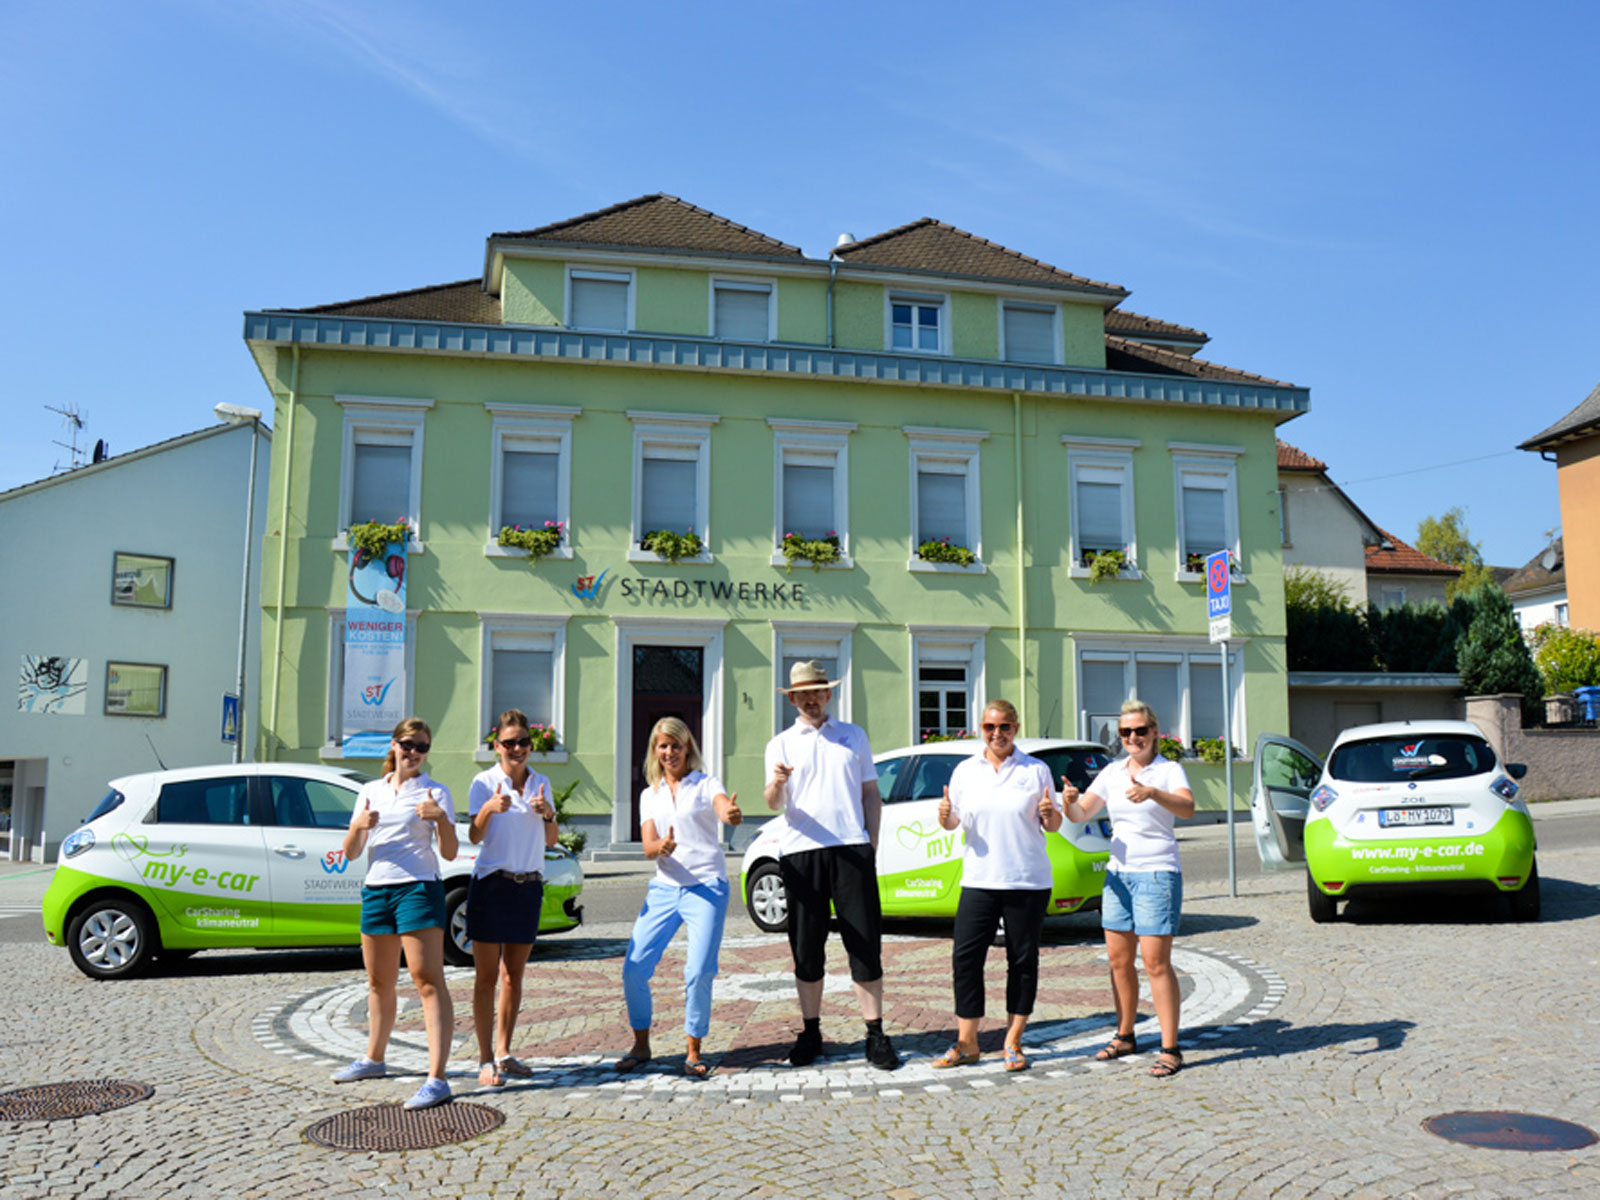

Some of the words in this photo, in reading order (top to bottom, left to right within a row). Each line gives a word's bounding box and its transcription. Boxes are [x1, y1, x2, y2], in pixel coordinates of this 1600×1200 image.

[620, 577, 804, 602] STADTWERKE
[1211, 596, 1229, 611] TAXI
[348, 621, 403, 631] WENIGER
[349, 631, 403, 641] KOSTEN!
[1352, 842, 1484, 860] www.my-e-car.de
[1369, 864, 1410, 874] CarSharing
[143, 861, 260, 892] my-e-car
[185, 907, 241, 918] CarSharing
[196, 918, 259, 928] klimaneutral
